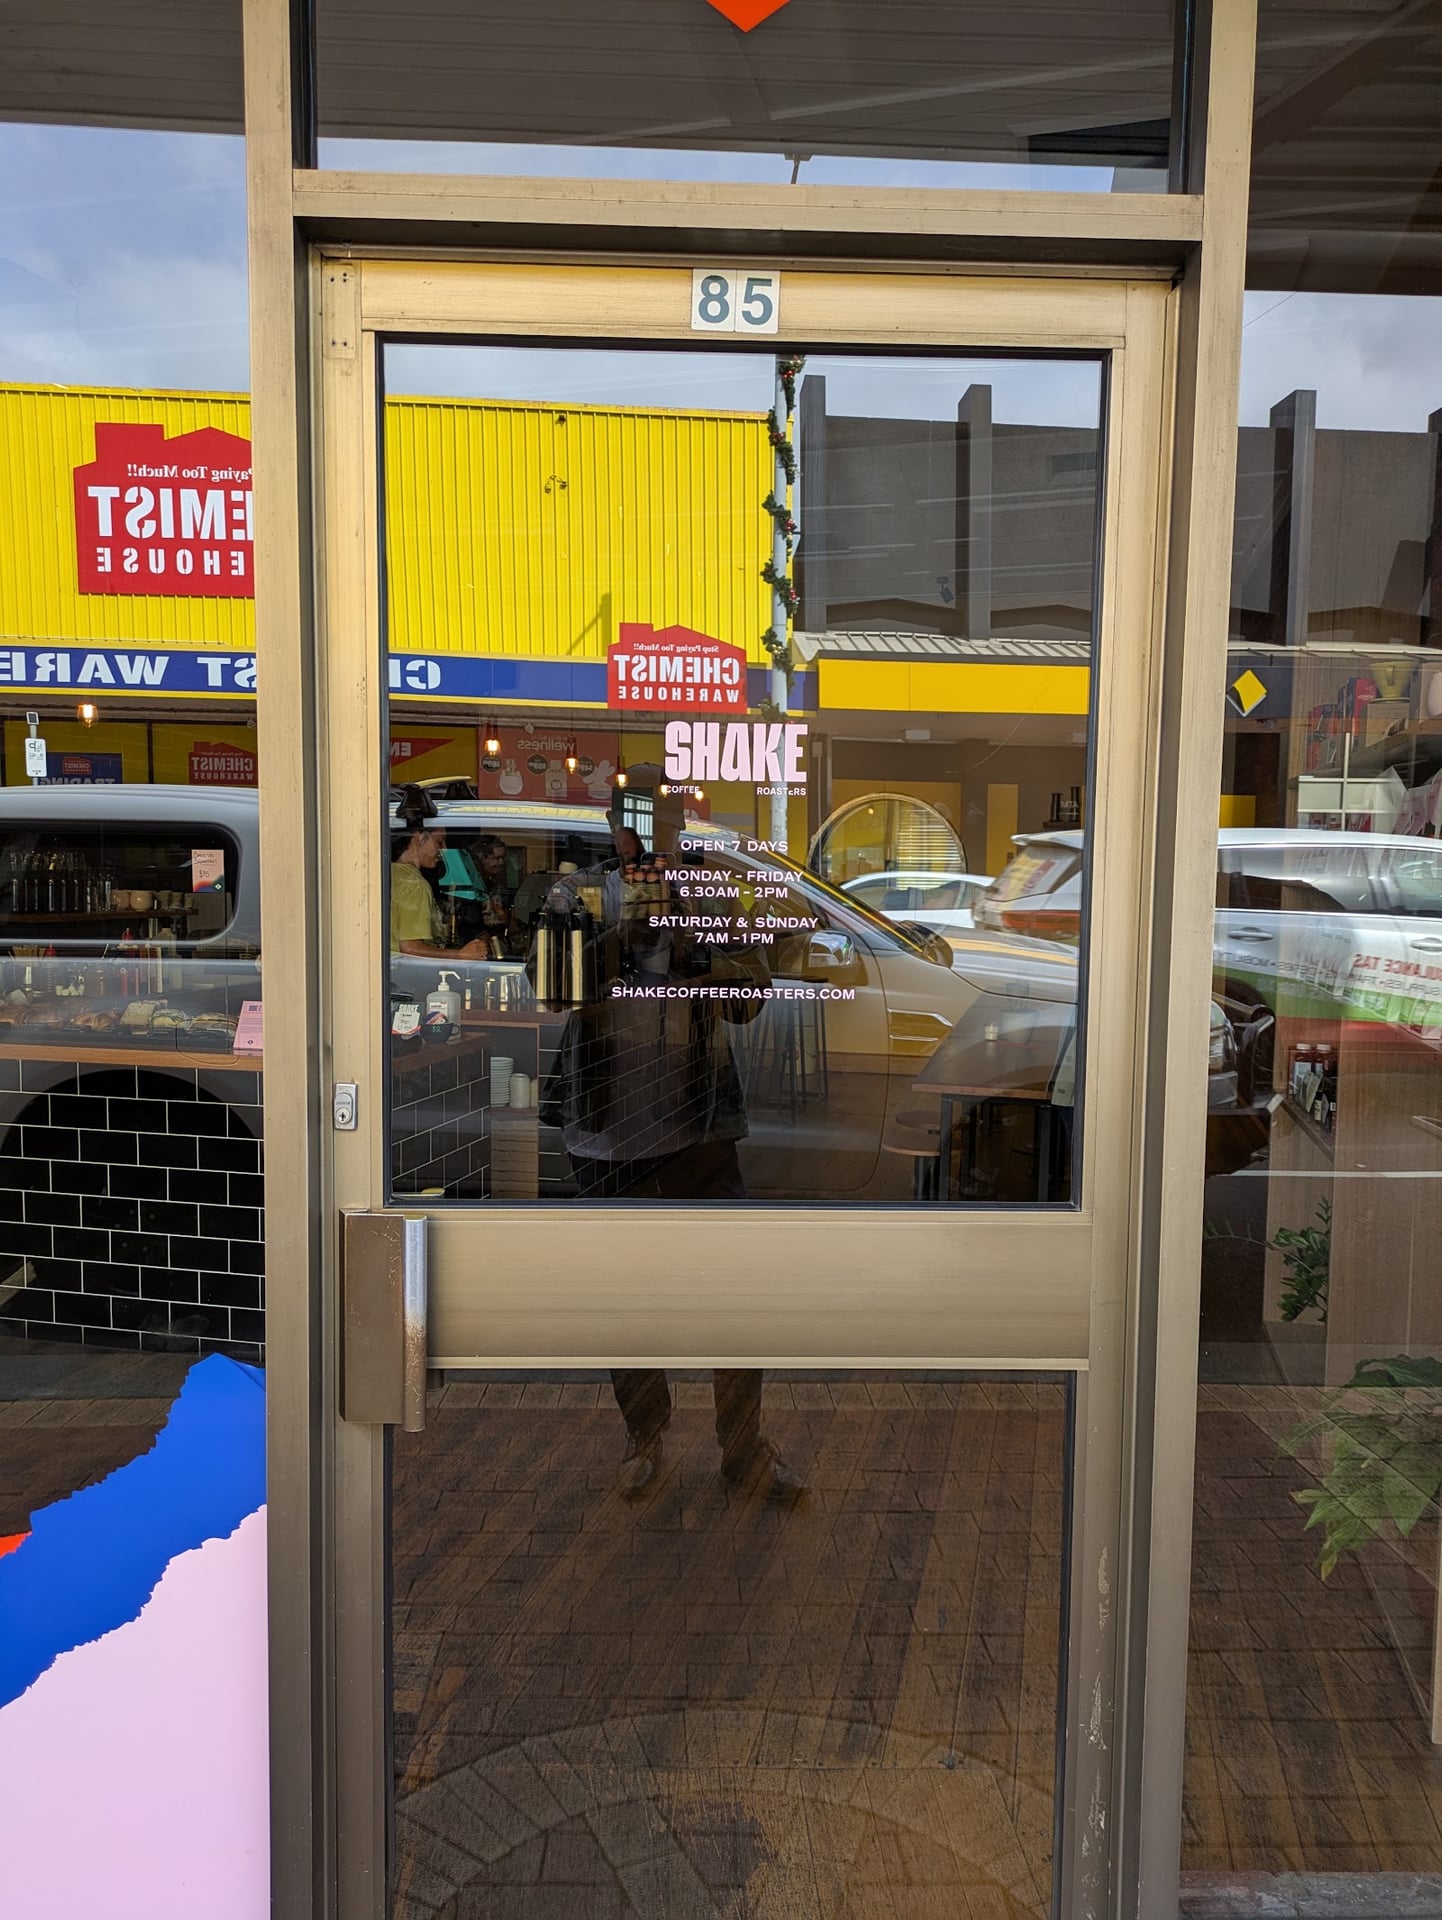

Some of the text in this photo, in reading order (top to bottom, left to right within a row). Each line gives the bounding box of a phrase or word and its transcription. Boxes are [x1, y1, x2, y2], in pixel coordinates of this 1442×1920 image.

[698, 274, 773, 325] 85
[665, 720, 808, 782] SHAKE
[757, 787, 806, 796] ROASTERS
[680, 840, 788, 852] OPEN 7 DAYS
[664, 870, 731, 882] MONDAY
[746, 870, 803, 883] FRIDAY
[679, 886, 739, 899] 6.30AM
[754, 887, 788, 899] 2PM
[648, 915, 819, 929] SATURDAY & SUNDAY
[694, 932, 728, 944] 7AM
[611, 986, 855, 1000] SHAKECOFFEEROASTERS.COM
